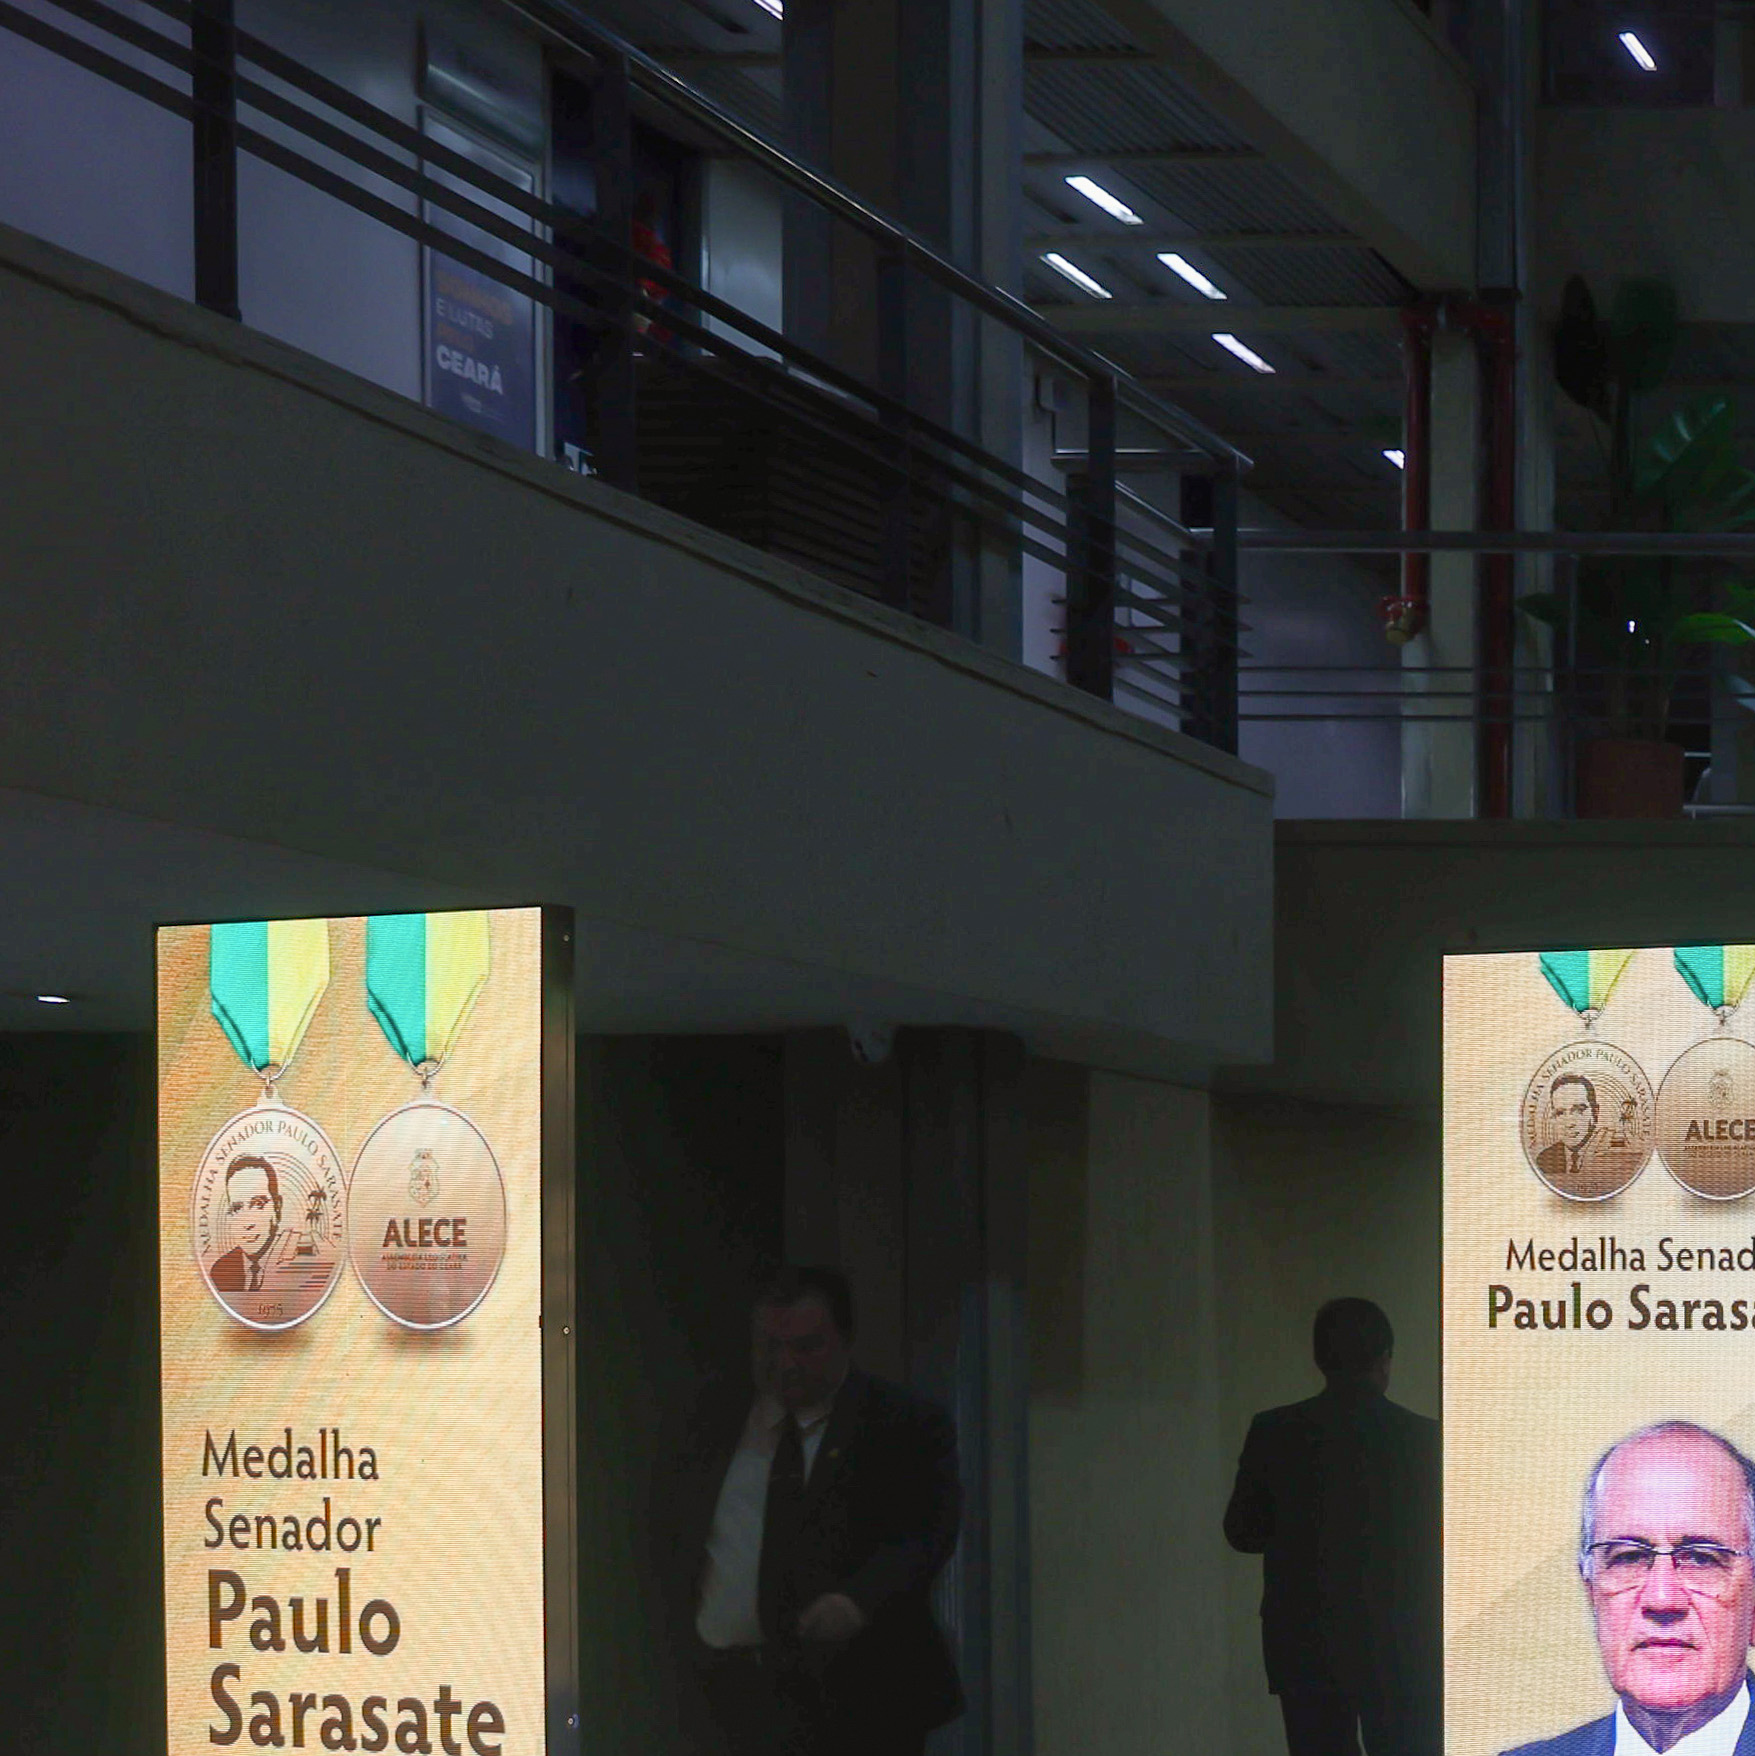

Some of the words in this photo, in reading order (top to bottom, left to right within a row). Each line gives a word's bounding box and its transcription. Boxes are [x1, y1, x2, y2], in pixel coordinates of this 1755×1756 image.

[436, 344, 504, 395] CEARÁ
[277, 1120, 319, 1156] PAULO
[382, 1217, 468, 1248] ALECE
[1506, 1237, 1646, 1272] Medalha
[1488, 1281, 1614, 1330] Paulo
[202, 1427, 380, 1481] Medalha
[203, 1498, 382, 1553] Senador
[207, 1568, 402, 1657] Paulo
